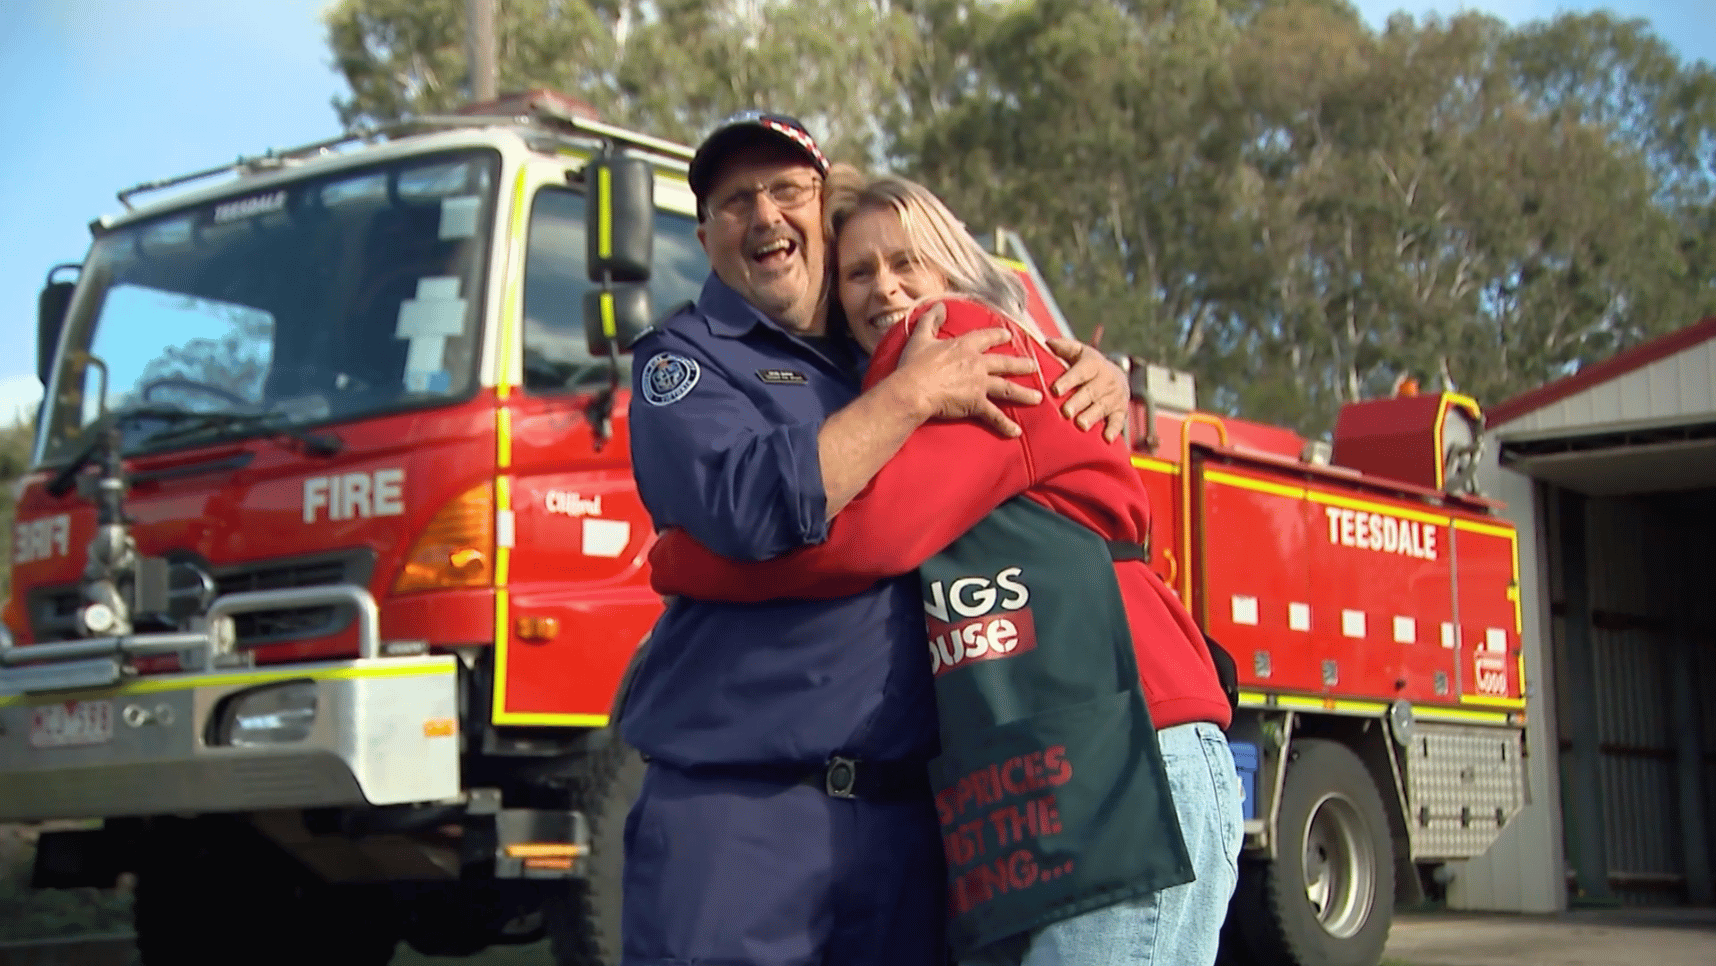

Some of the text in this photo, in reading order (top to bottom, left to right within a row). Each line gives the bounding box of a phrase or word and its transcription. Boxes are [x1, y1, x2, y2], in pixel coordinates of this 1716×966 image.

[214, 190, 287, 222] TEESDALE
[303, 468, 404, 524] FIRE
[1325, 506, 1437, 562] TEESDALE
[988, 793, 1063, 847] THE
